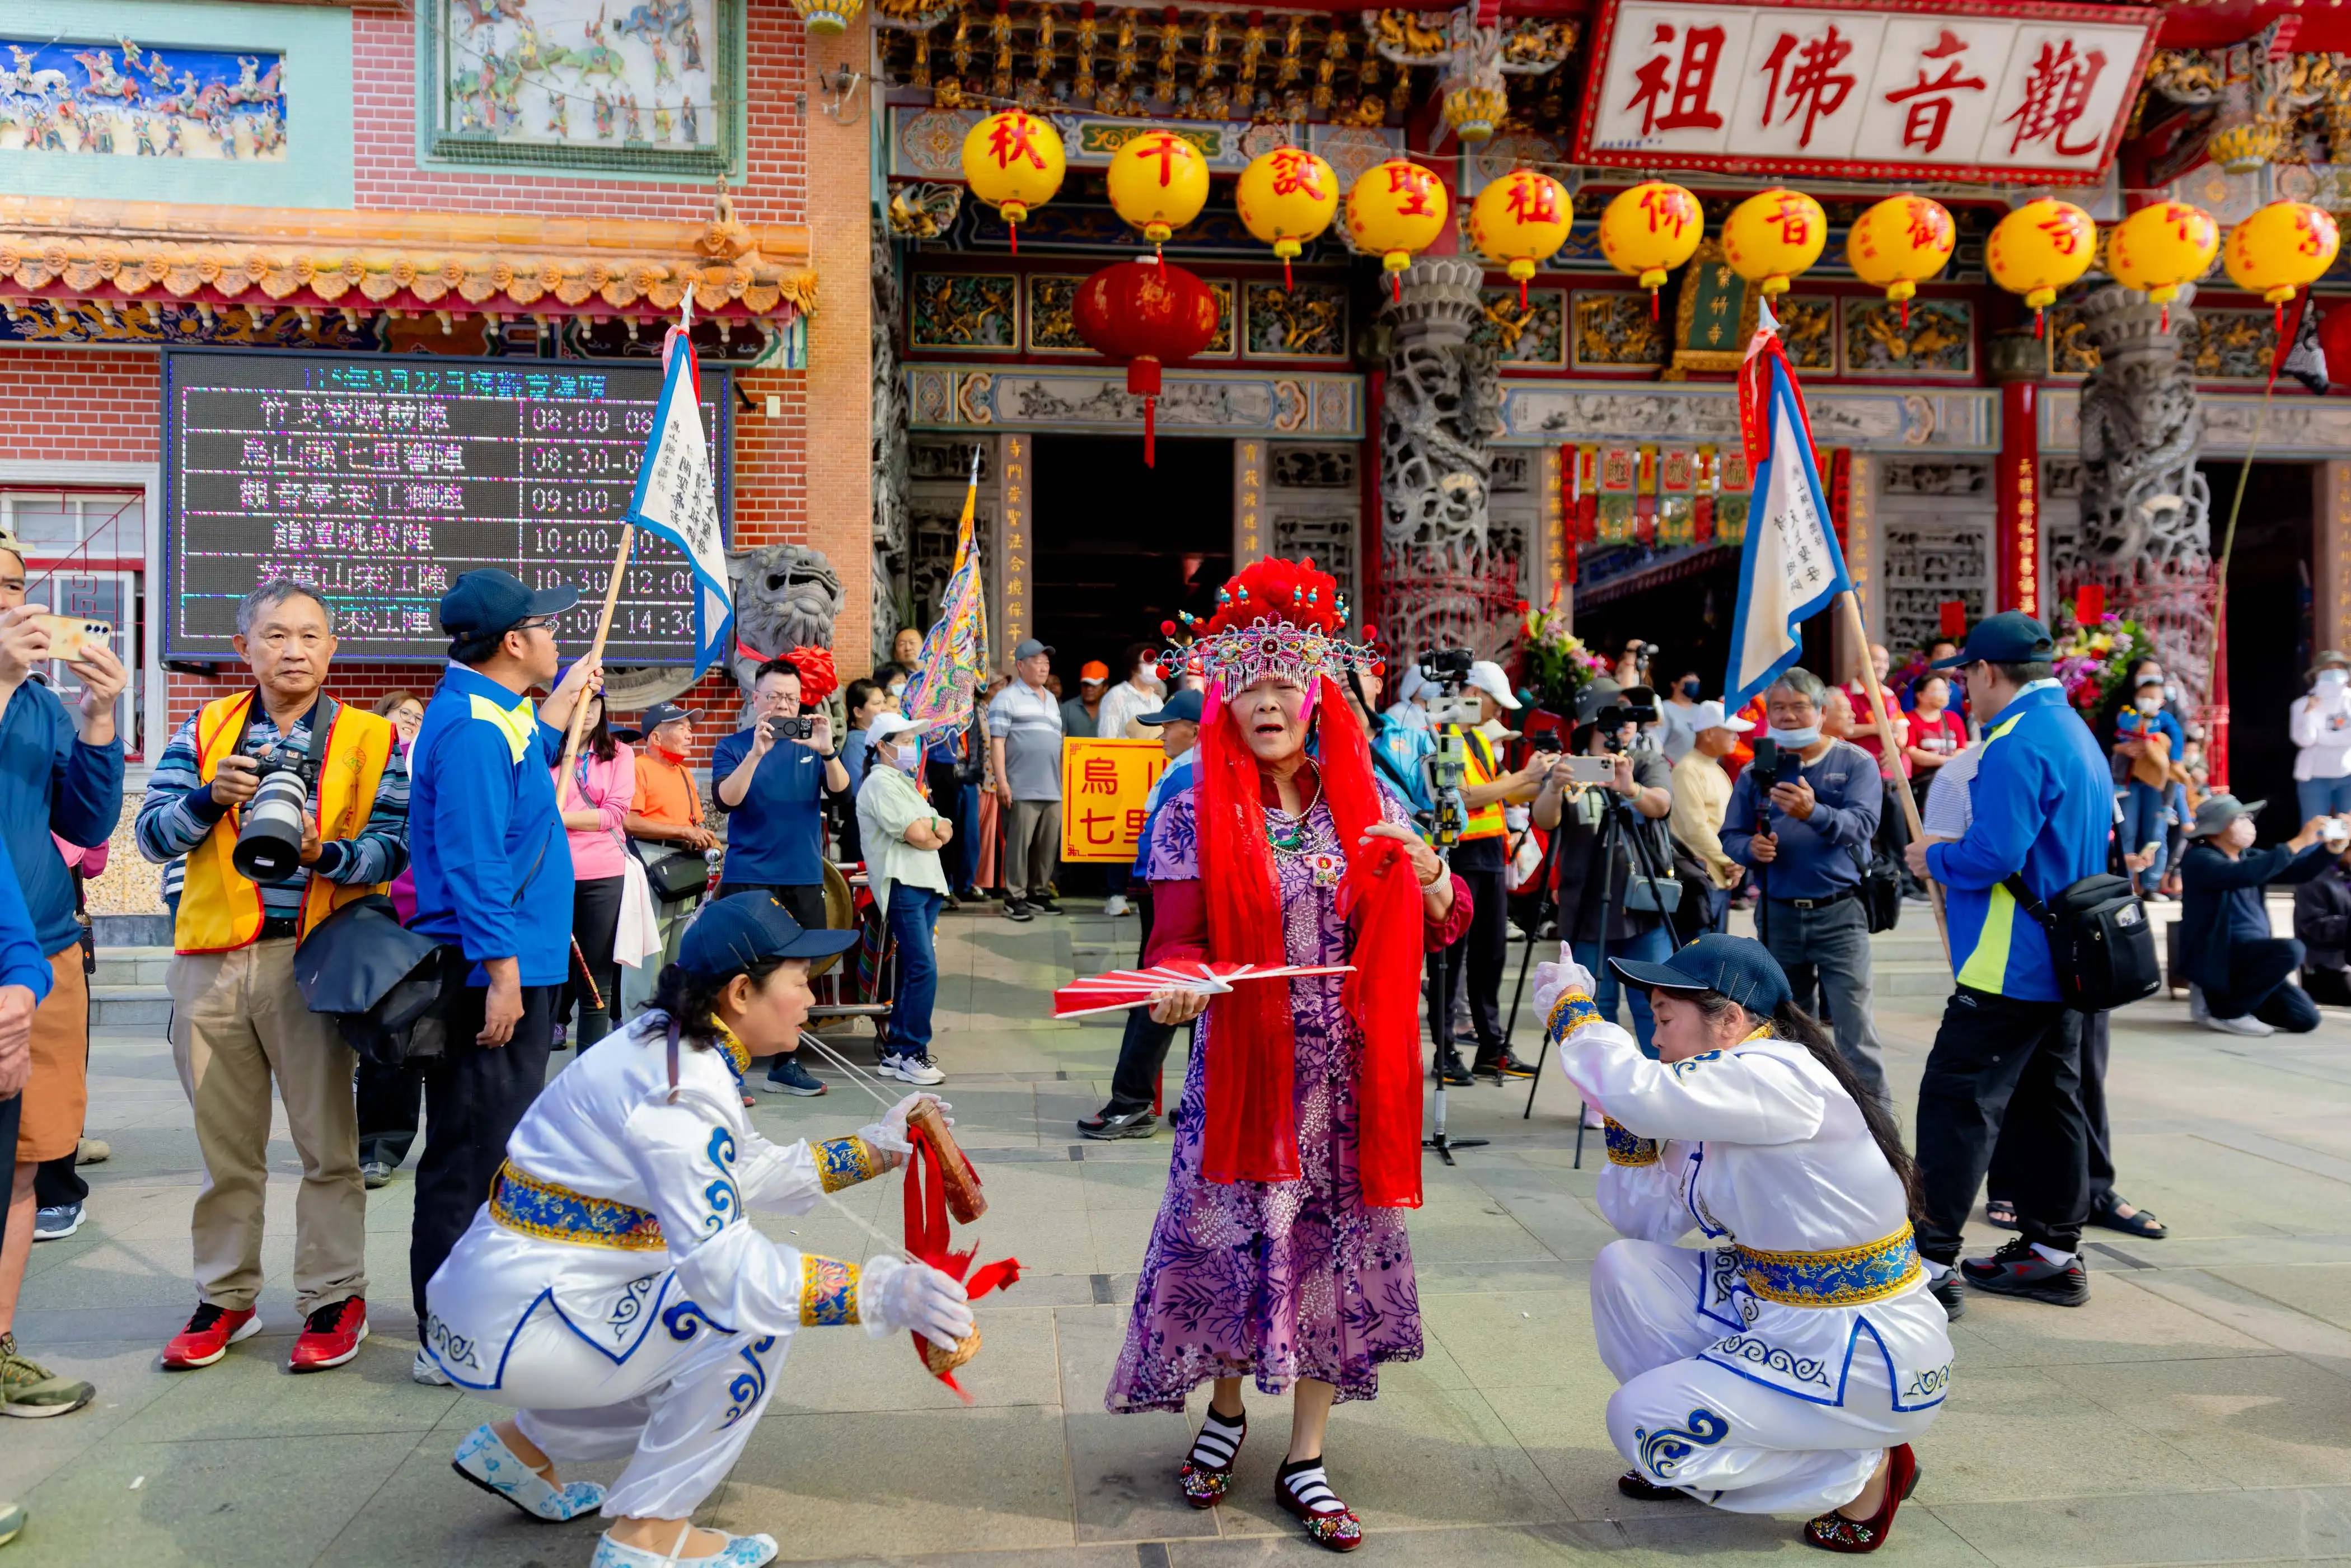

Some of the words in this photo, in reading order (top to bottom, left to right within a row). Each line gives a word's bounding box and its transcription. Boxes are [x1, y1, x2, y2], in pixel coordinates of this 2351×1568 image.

[989, 114, 1046, 170] 秋
[1136, 134, 1192, 188] 千
[1271, 150, 1326, 200] 誕
[1385, 165, 1437, 217] 聖
[1506, 176, 1561, 225] 祖
[1641, 186, 1694, 238] 佛
[1767, 193, 1818, 246] 音
[533, 447, 646, 474] 08:30-0
